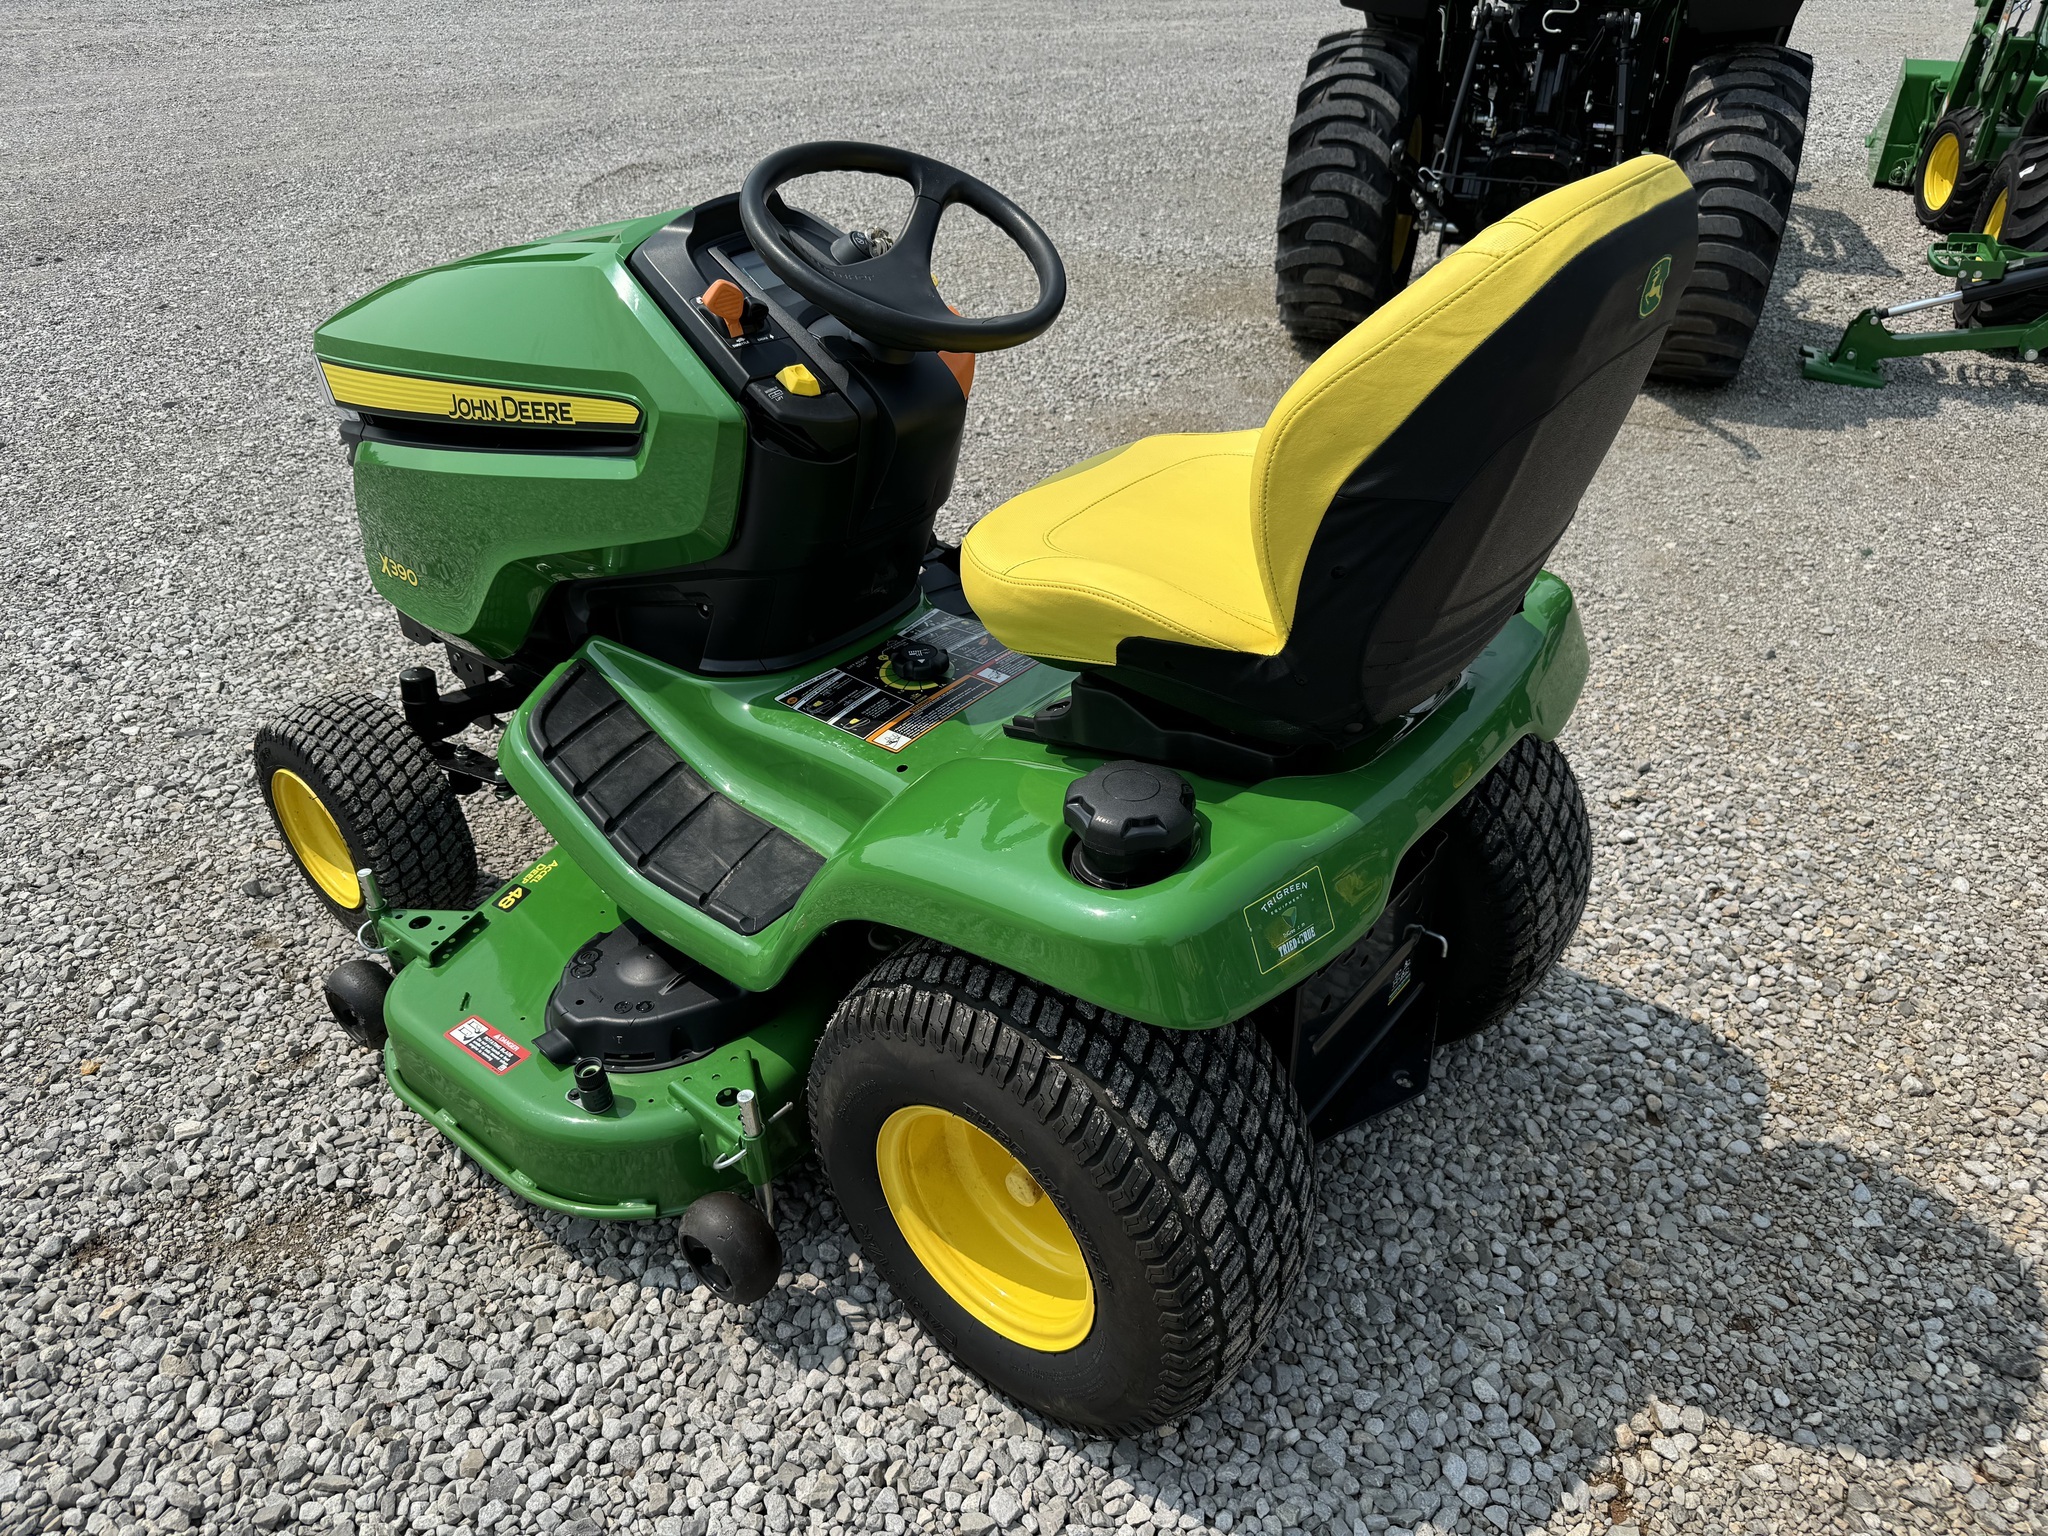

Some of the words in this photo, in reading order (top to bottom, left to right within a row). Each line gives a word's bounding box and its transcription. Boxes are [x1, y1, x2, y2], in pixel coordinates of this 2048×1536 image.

[448, 393, 500, 420] JOHN
[501, 396, 575, 424] DEERE
[378, 551, 418, 587] X390
[521, 863, 547, 885] DEEP
[529, 859, 559, 884] ACCEL
[498, 887, 523, 909] 48
[1261, 881, 1308, 913] TRIGREEN
[1270, 893, 1303, 916] EQUIPMENT
[1278, 938, 1298, 957] TRIED
[498, 1036, 520, 1052] DANGER
[963, 1101, 1027, 1157] TURF
[1031, 1166, 1115, 1290] MASTER
